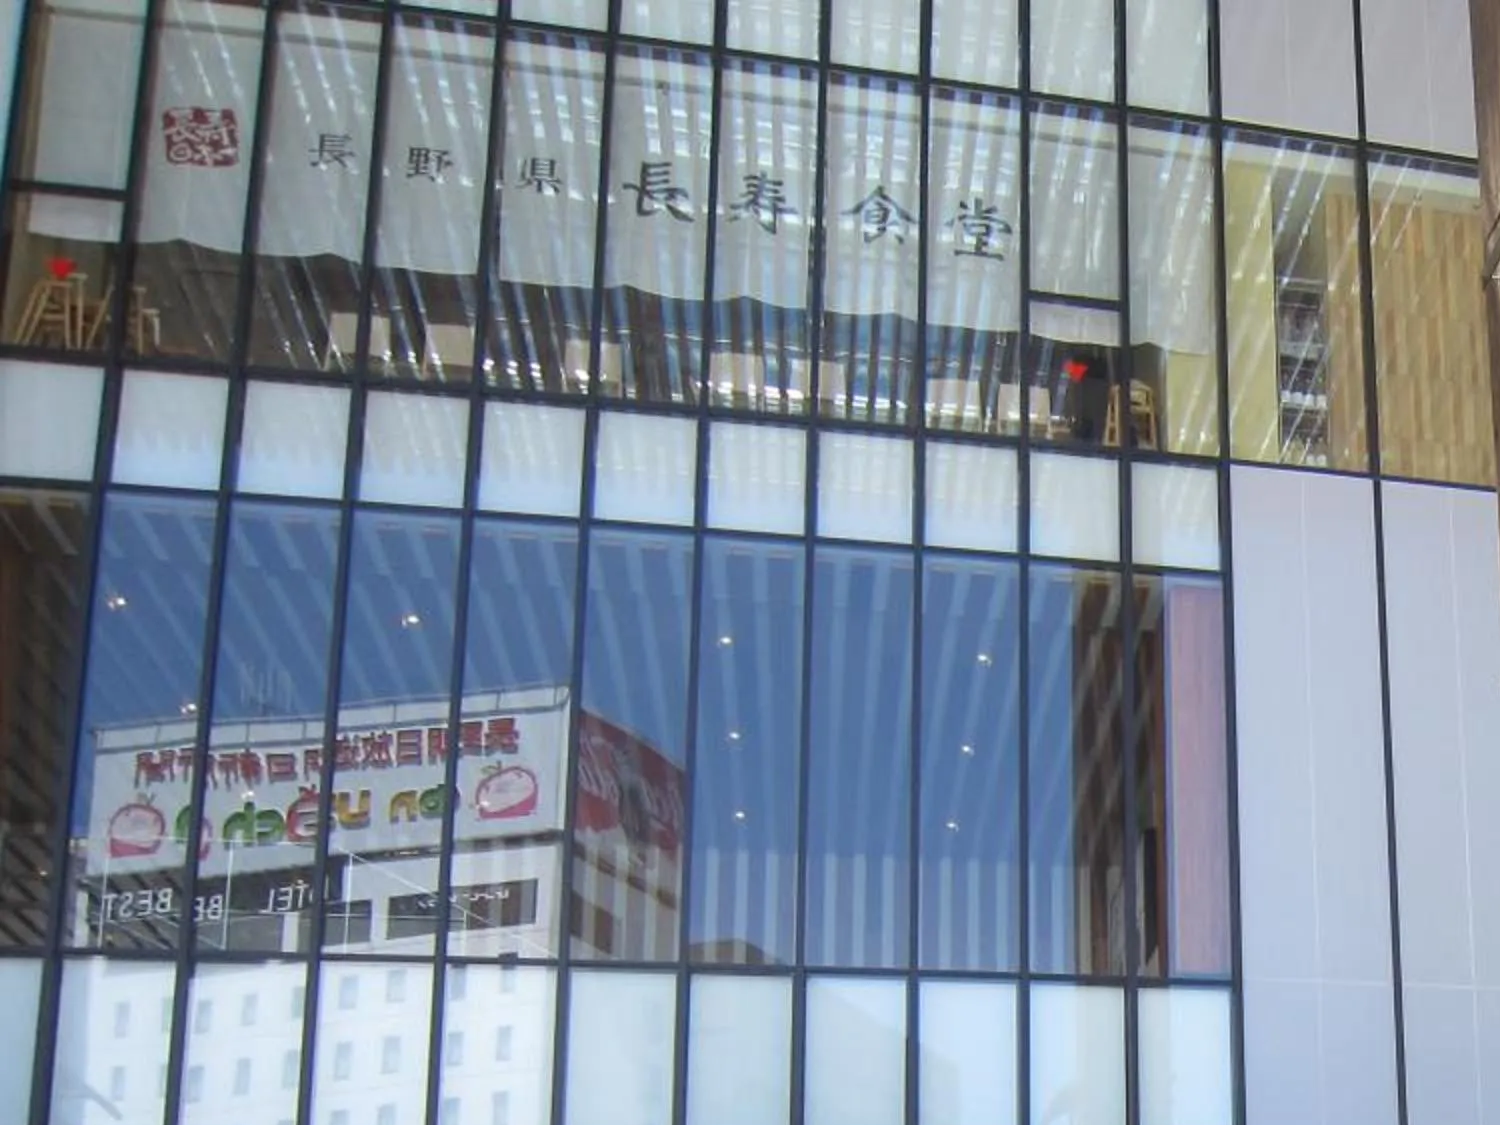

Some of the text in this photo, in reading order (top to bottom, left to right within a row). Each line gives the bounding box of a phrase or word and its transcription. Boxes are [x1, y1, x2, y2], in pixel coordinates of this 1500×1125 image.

[308, 132, 1014, 262] 長野県 長寿食堂
